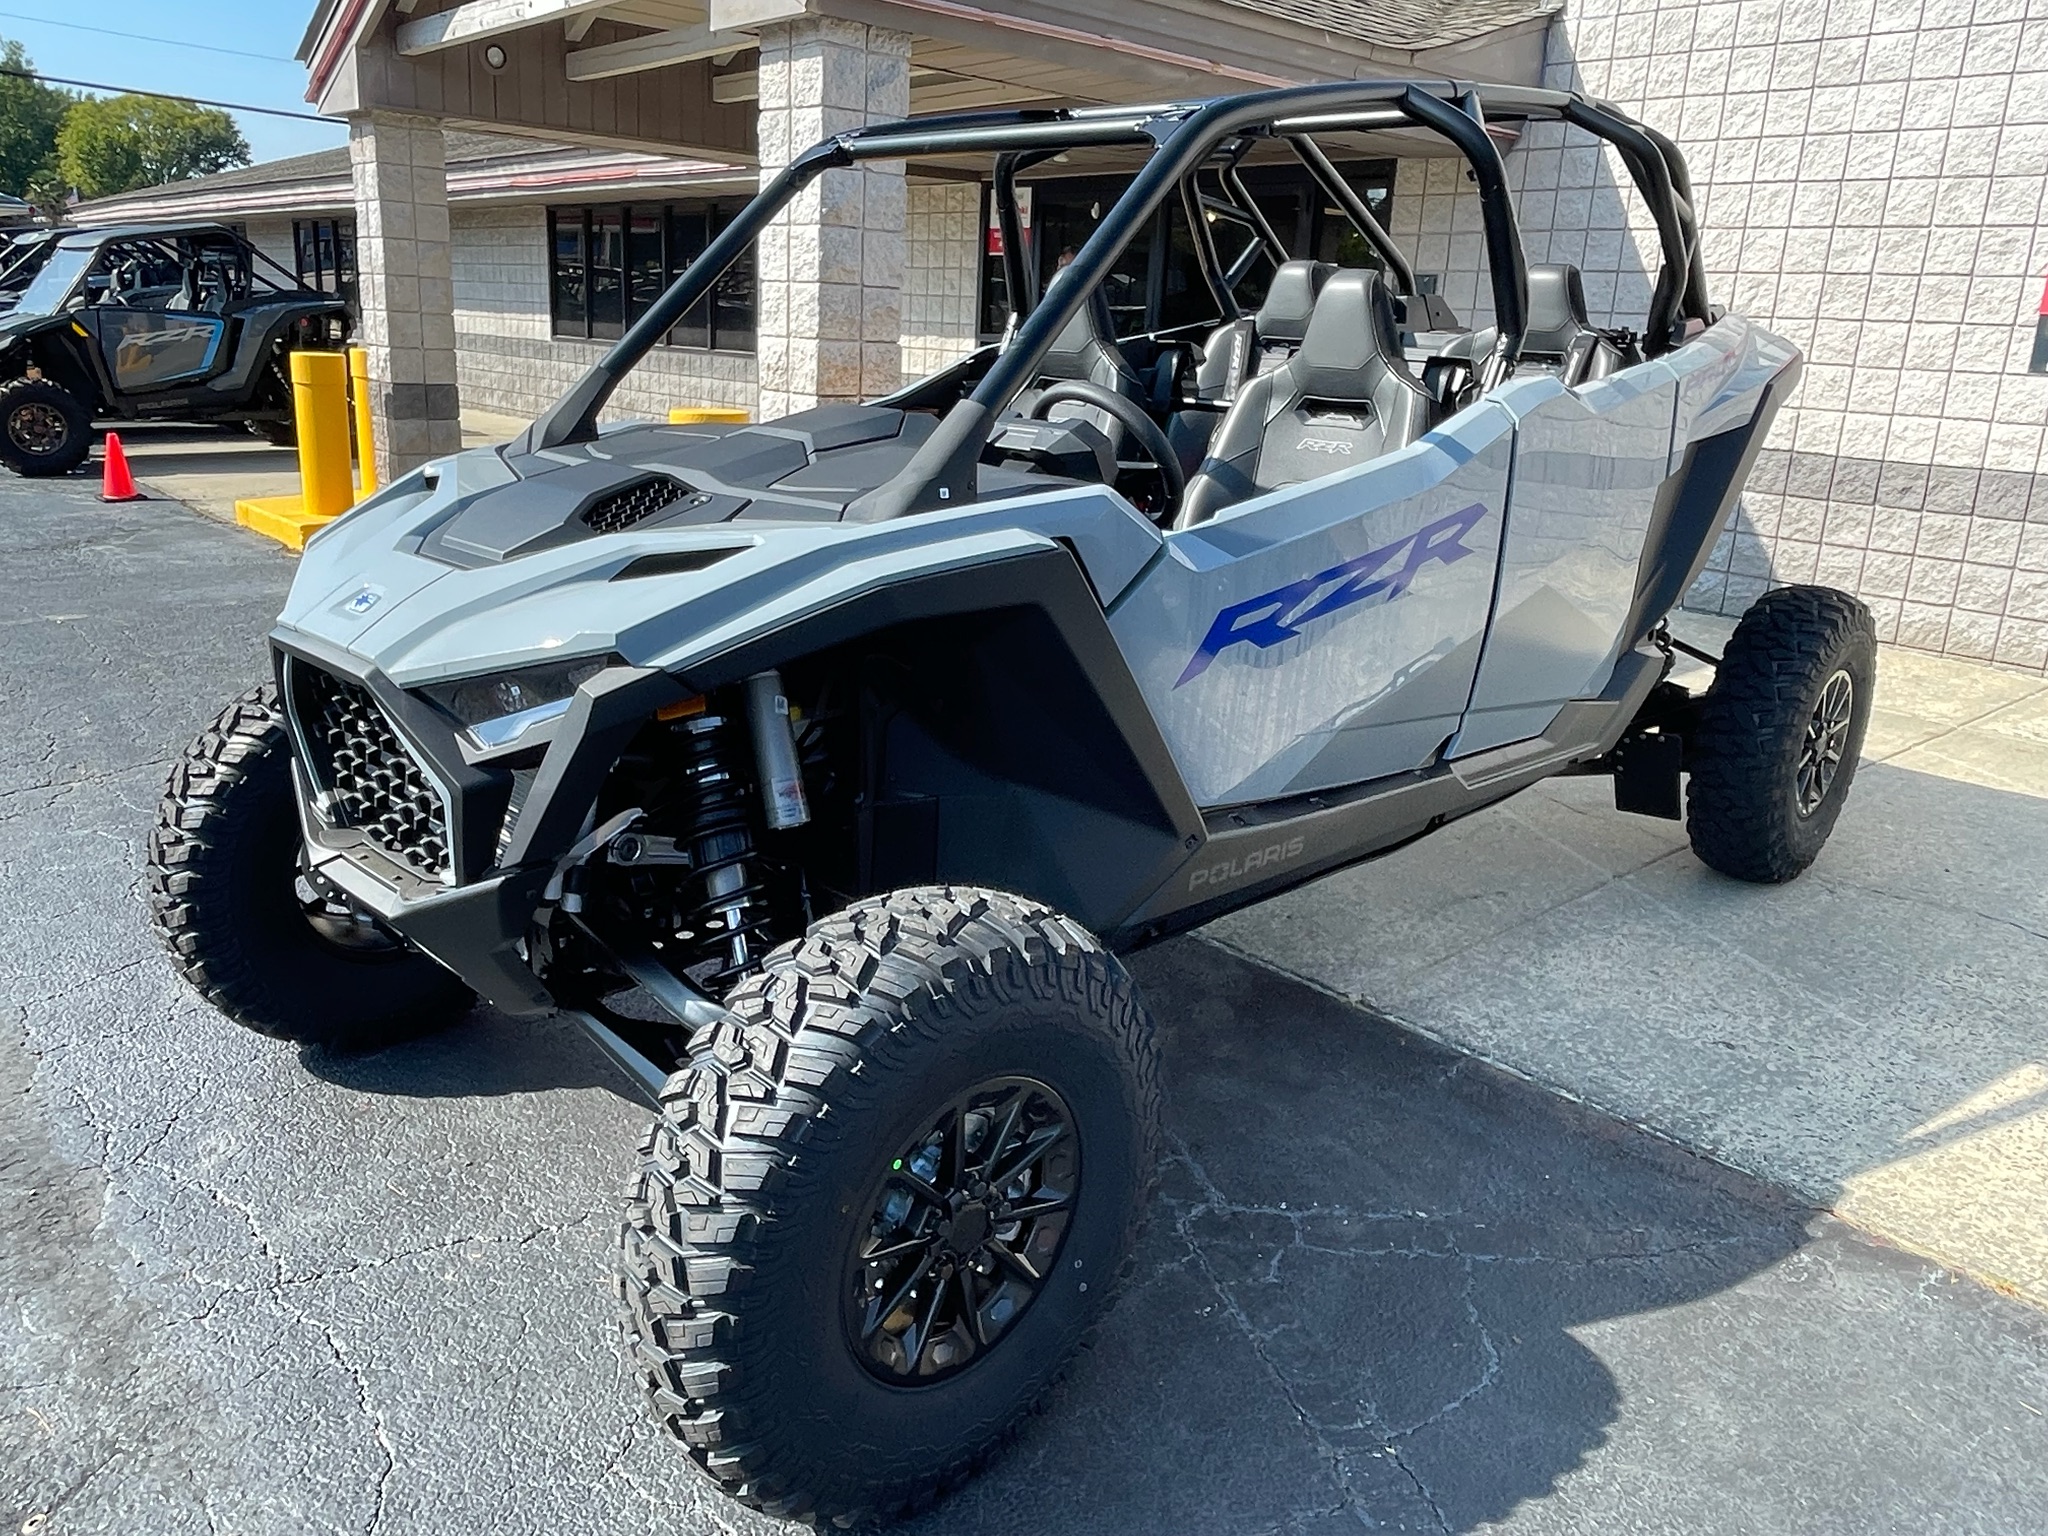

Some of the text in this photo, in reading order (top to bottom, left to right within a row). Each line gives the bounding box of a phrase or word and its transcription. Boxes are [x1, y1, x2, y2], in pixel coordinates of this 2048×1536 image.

[116, 325, 216, 352] RZR
[1296, 438, 1353, 455] RZR
[1173, 502, 1488, 690] RZR
[1188, 836, 1305, 891] POLARIS
